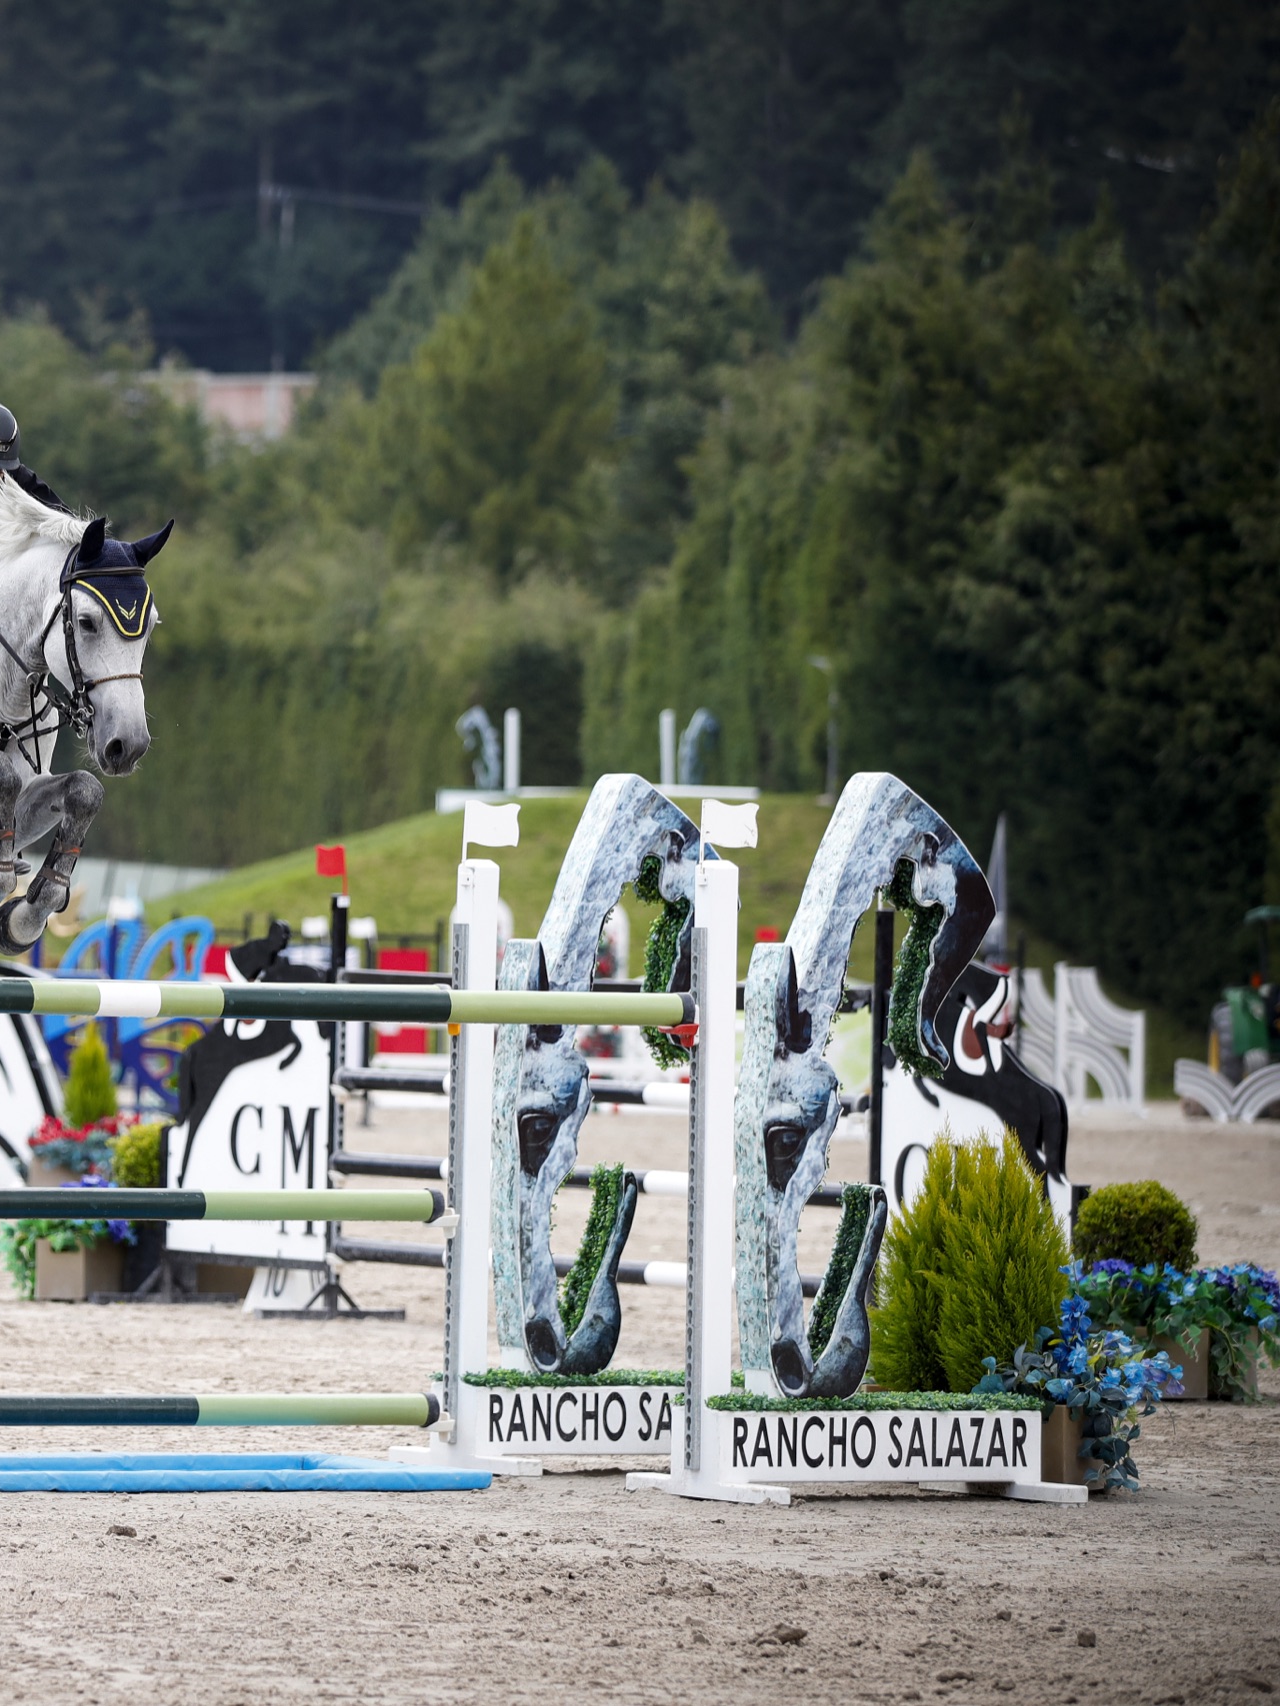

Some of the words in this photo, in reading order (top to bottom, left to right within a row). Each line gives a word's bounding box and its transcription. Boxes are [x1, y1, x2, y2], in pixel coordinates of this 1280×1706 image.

[489, 1391, 627, 1443] RANCHO
[733, 1415, 876, 1468] RANCHO
[888, 1416, 1027, 1469] SALAZAR
